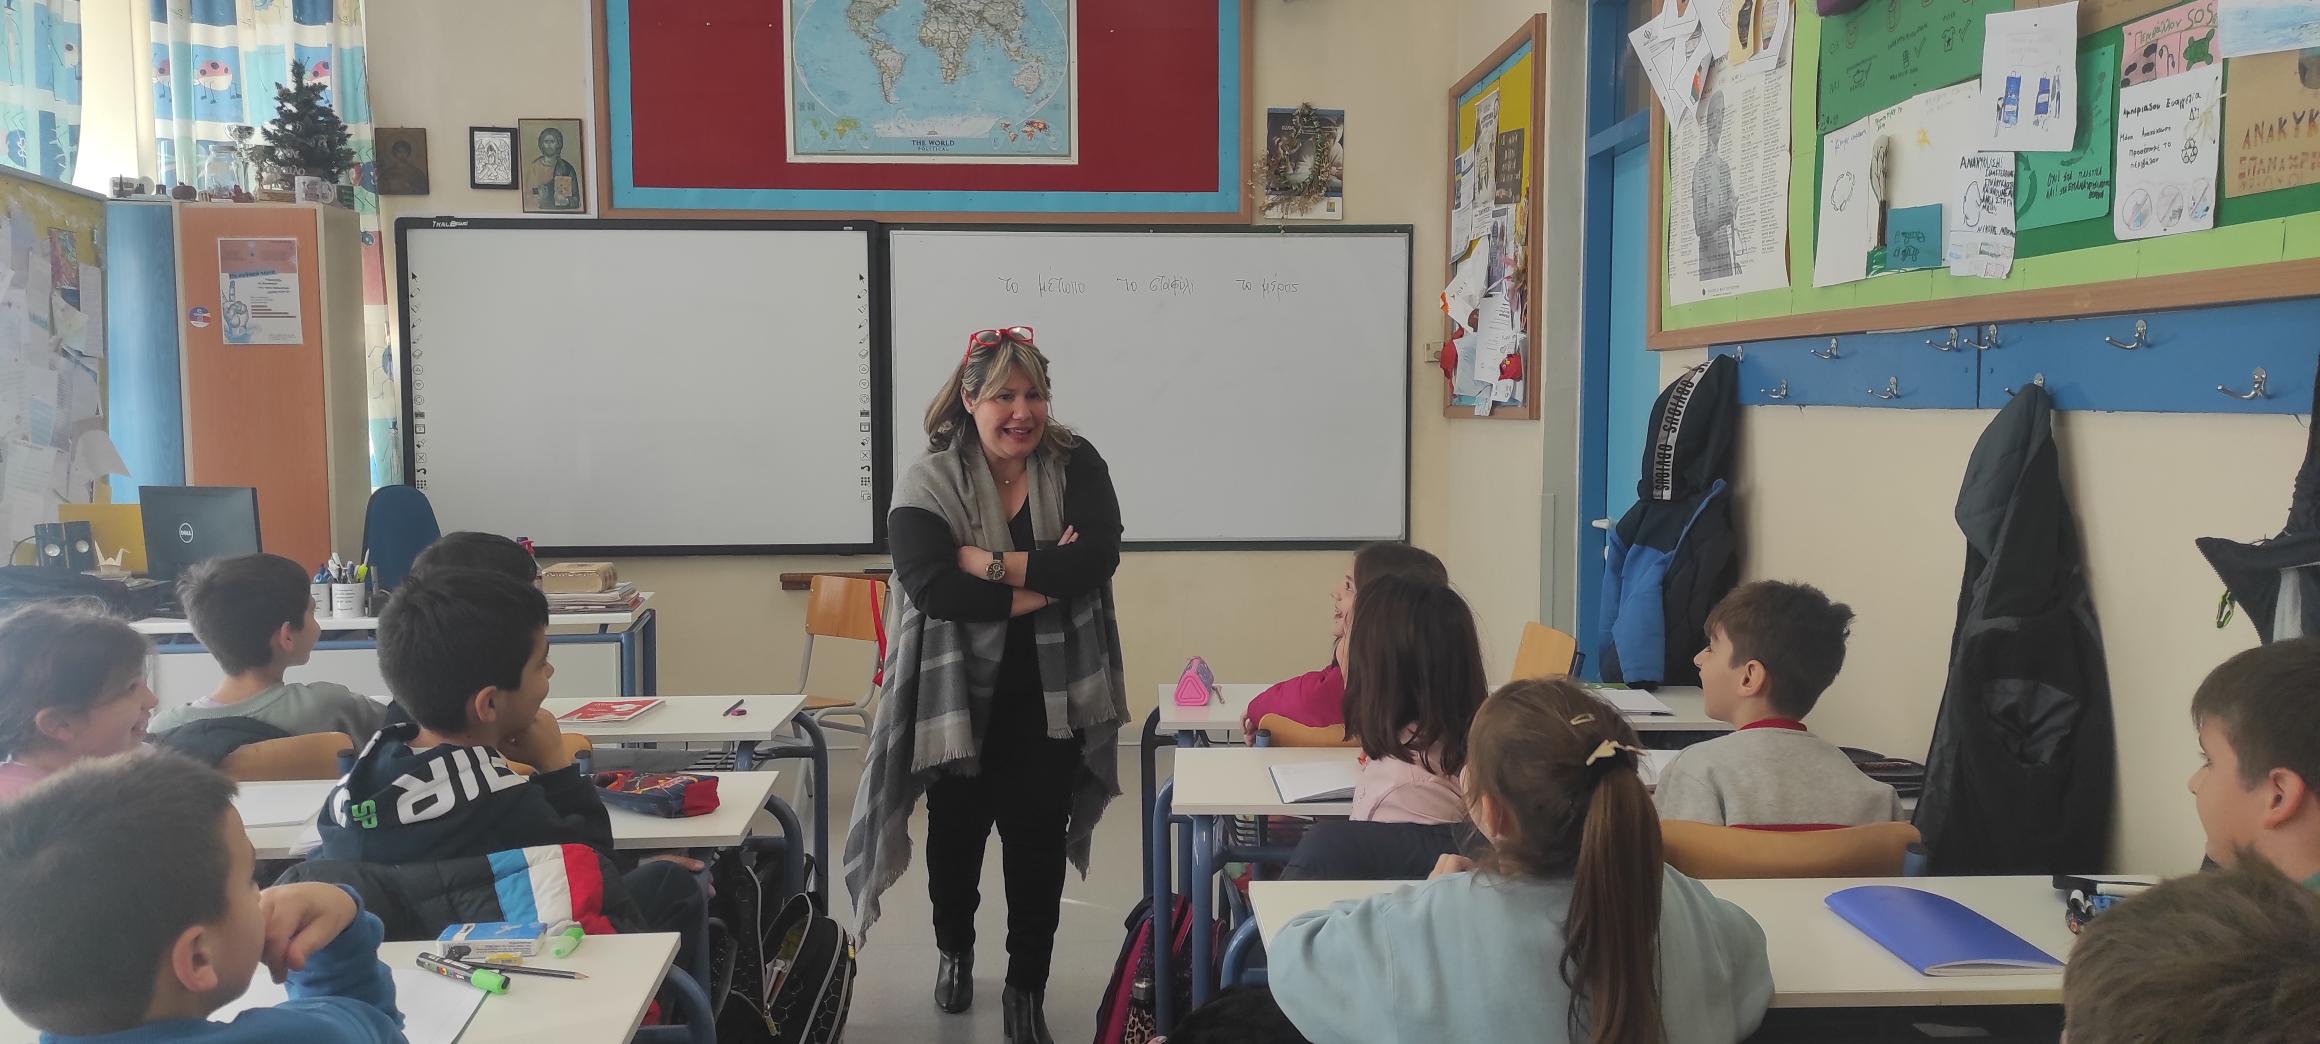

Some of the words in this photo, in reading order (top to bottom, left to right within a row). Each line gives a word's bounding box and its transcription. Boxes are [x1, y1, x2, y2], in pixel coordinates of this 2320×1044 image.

[928, 139, 955, 147] WORLD
[1662, 379, 1695, 434] OBVIOUS
[1655, 443, 1673, 492] OBVIOUS
